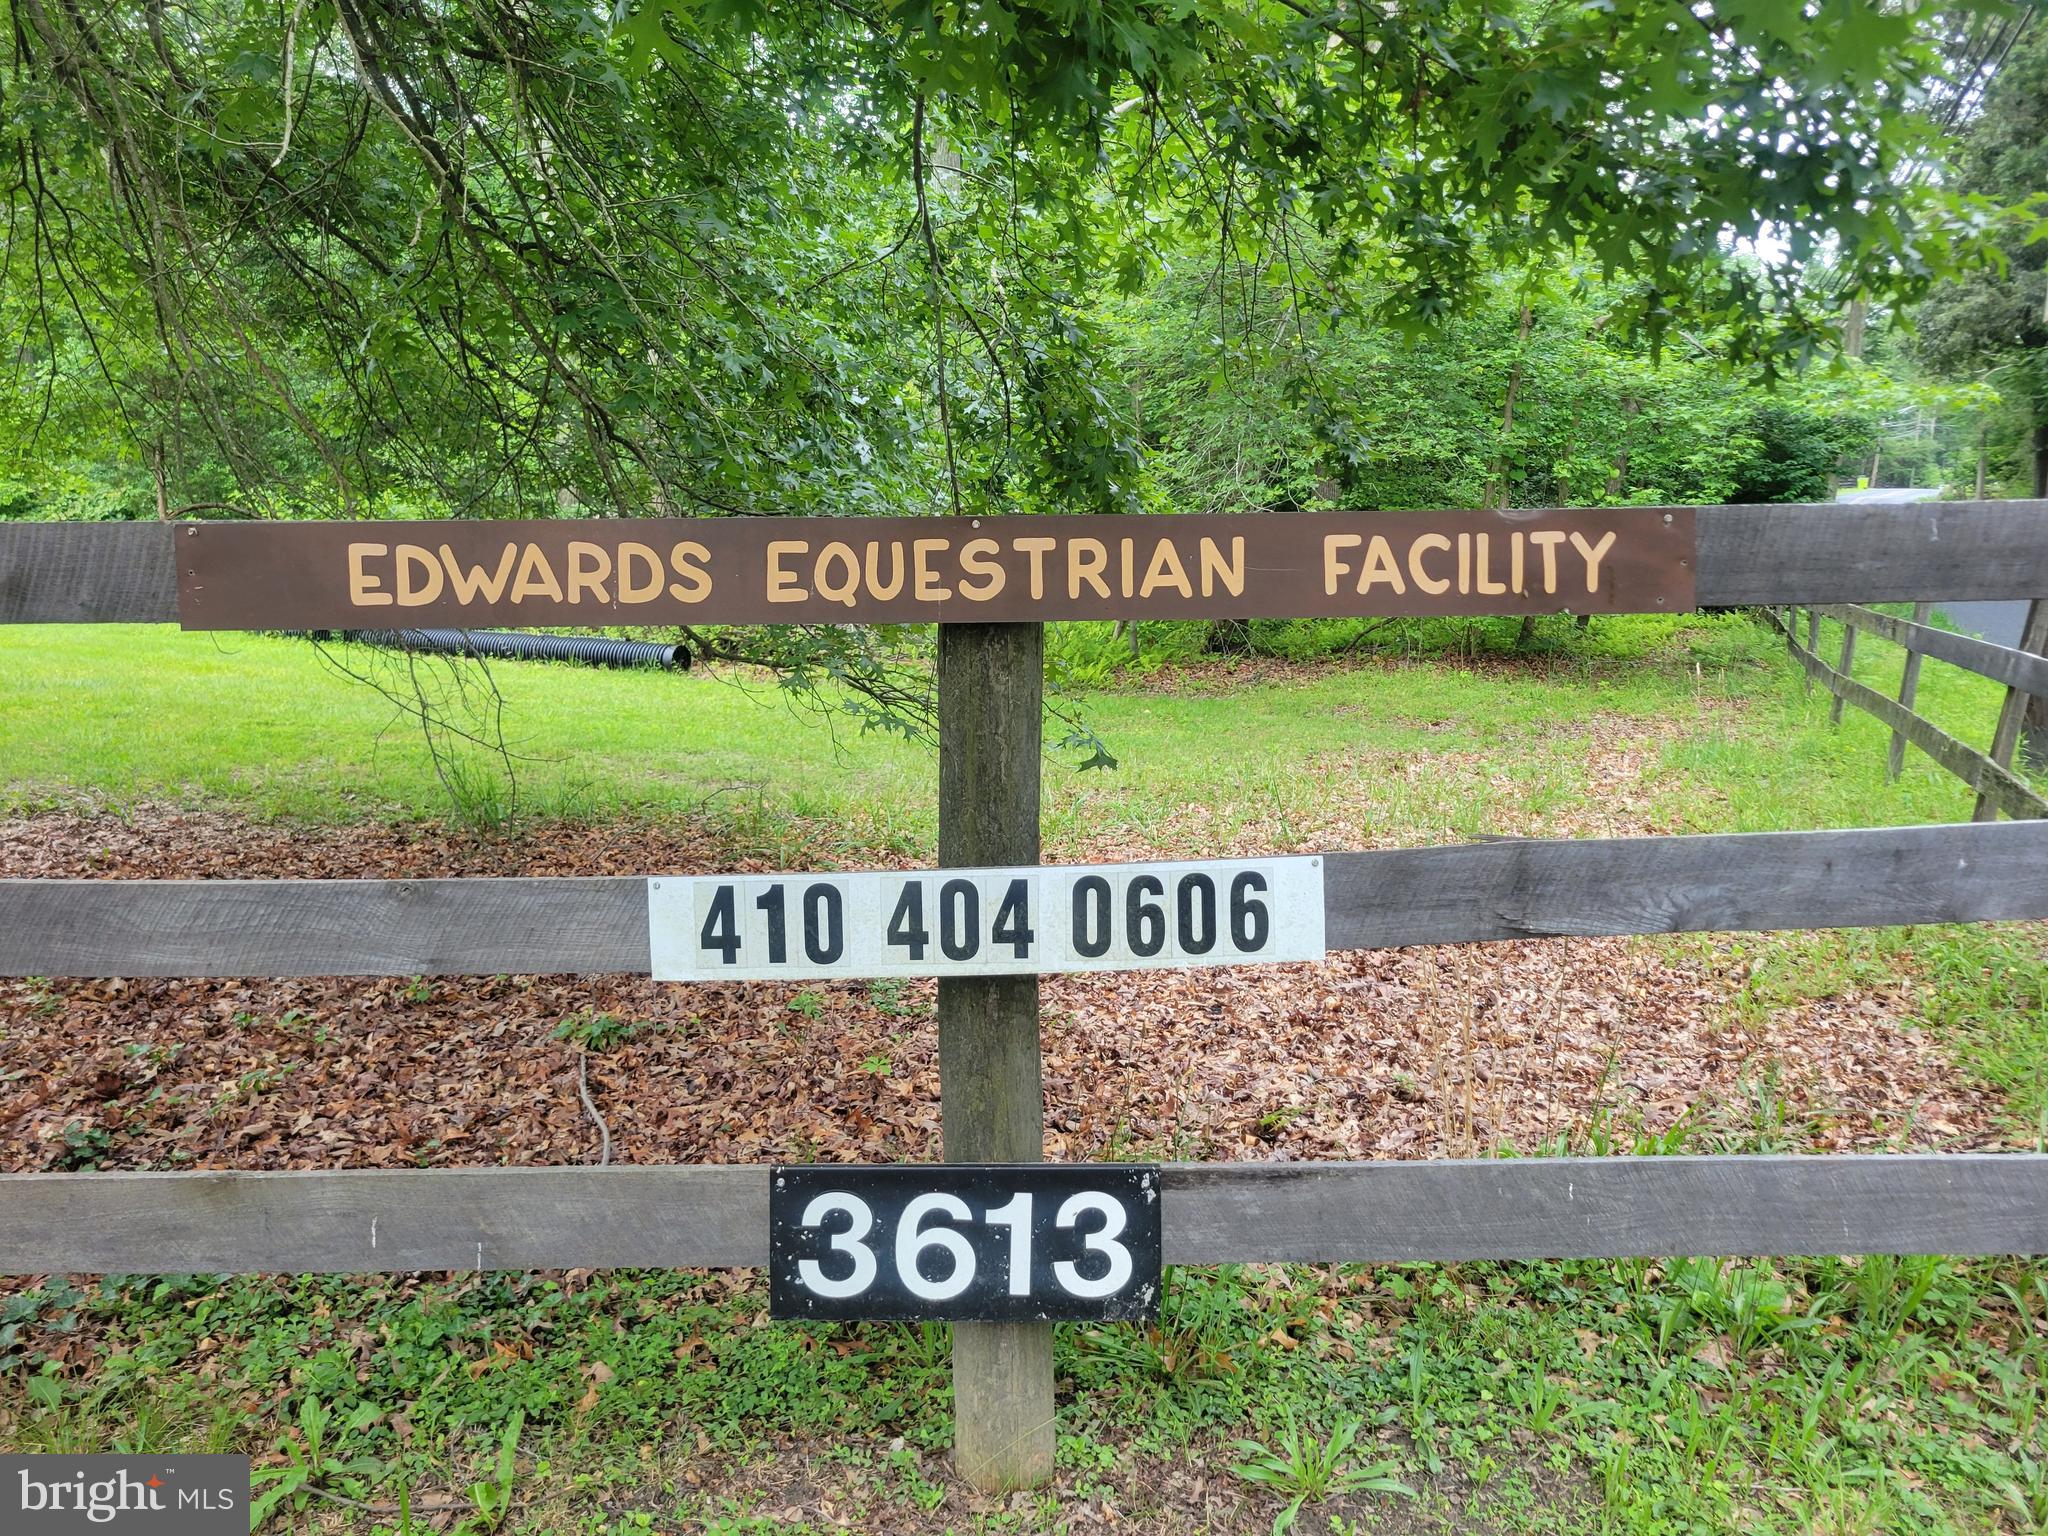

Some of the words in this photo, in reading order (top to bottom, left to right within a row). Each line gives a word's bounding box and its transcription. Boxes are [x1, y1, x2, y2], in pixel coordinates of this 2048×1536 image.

[347, 540, 713, 607] EDWARDS
[766, 533, 1245, 608] EQUESTRIAN
[1323, 530, 1617, 596] FACILITY
[700, 882, 844, 965] 410
[887, 879, 1034, 961] 404
[1072, 871, 1270, 958] 0606
[797, 1190, 1134, 1302] 3613
